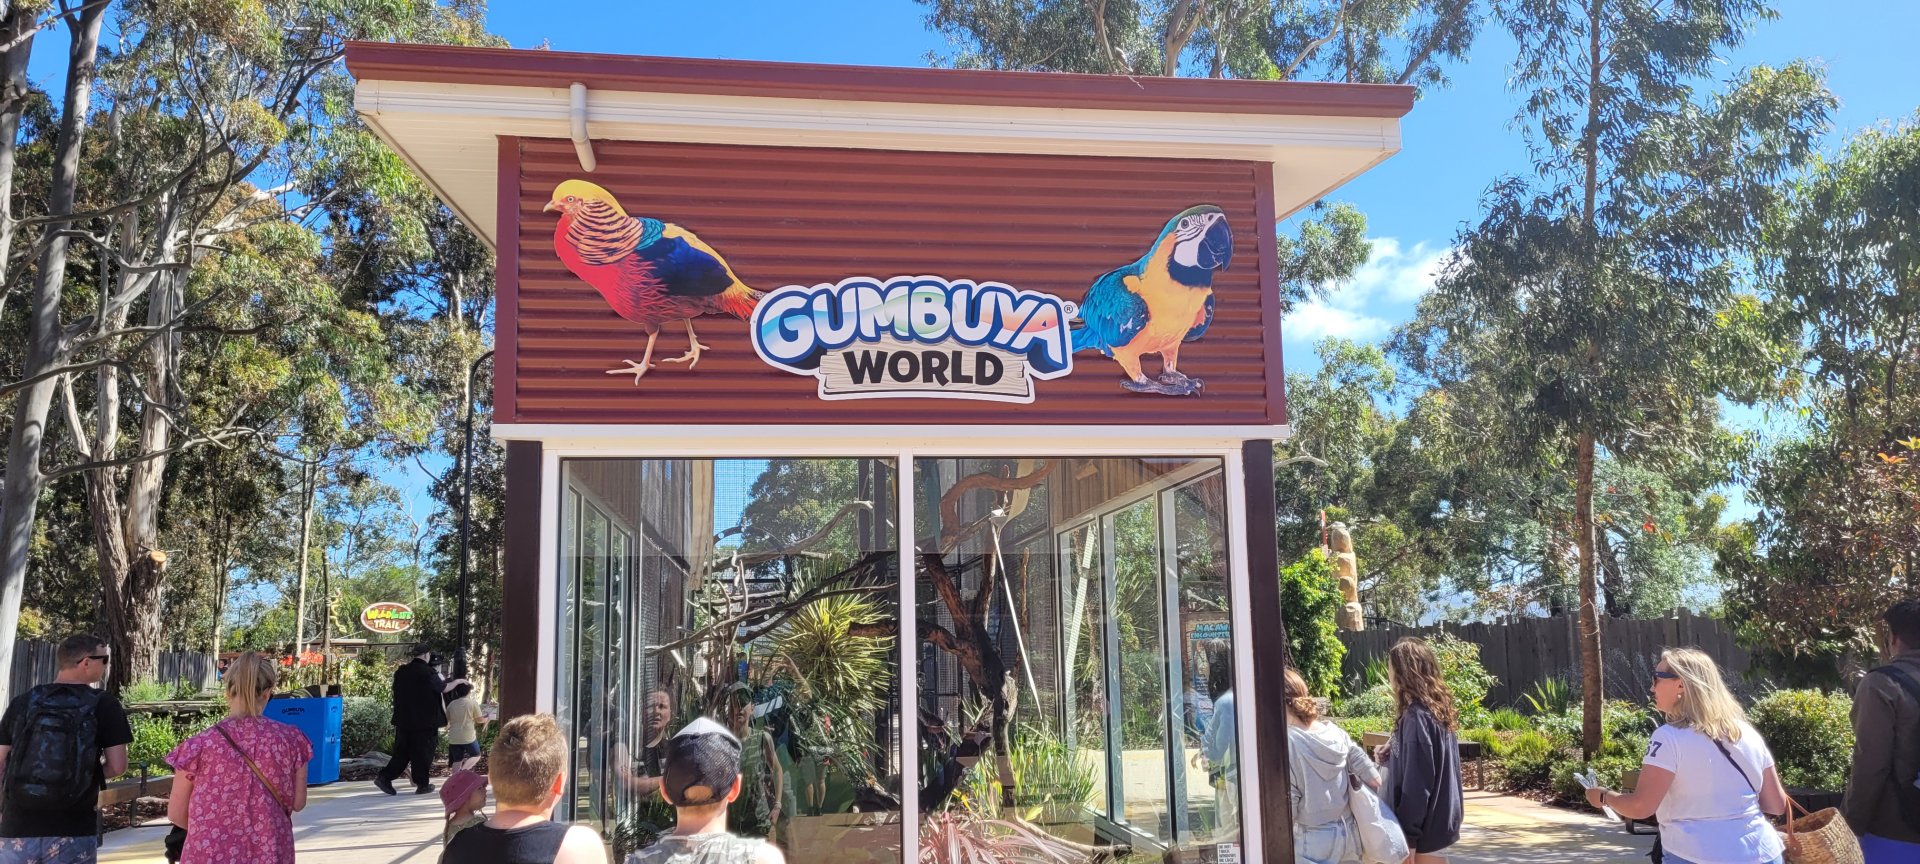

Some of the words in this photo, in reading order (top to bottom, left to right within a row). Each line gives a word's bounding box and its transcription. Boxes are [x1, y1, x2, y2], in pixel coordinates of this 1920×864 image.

[757, 283, 1067, 372] GUMBUYA
[844, 350, 1003, 387] WORLD
[373, 619, 401, 630] TRAIL
